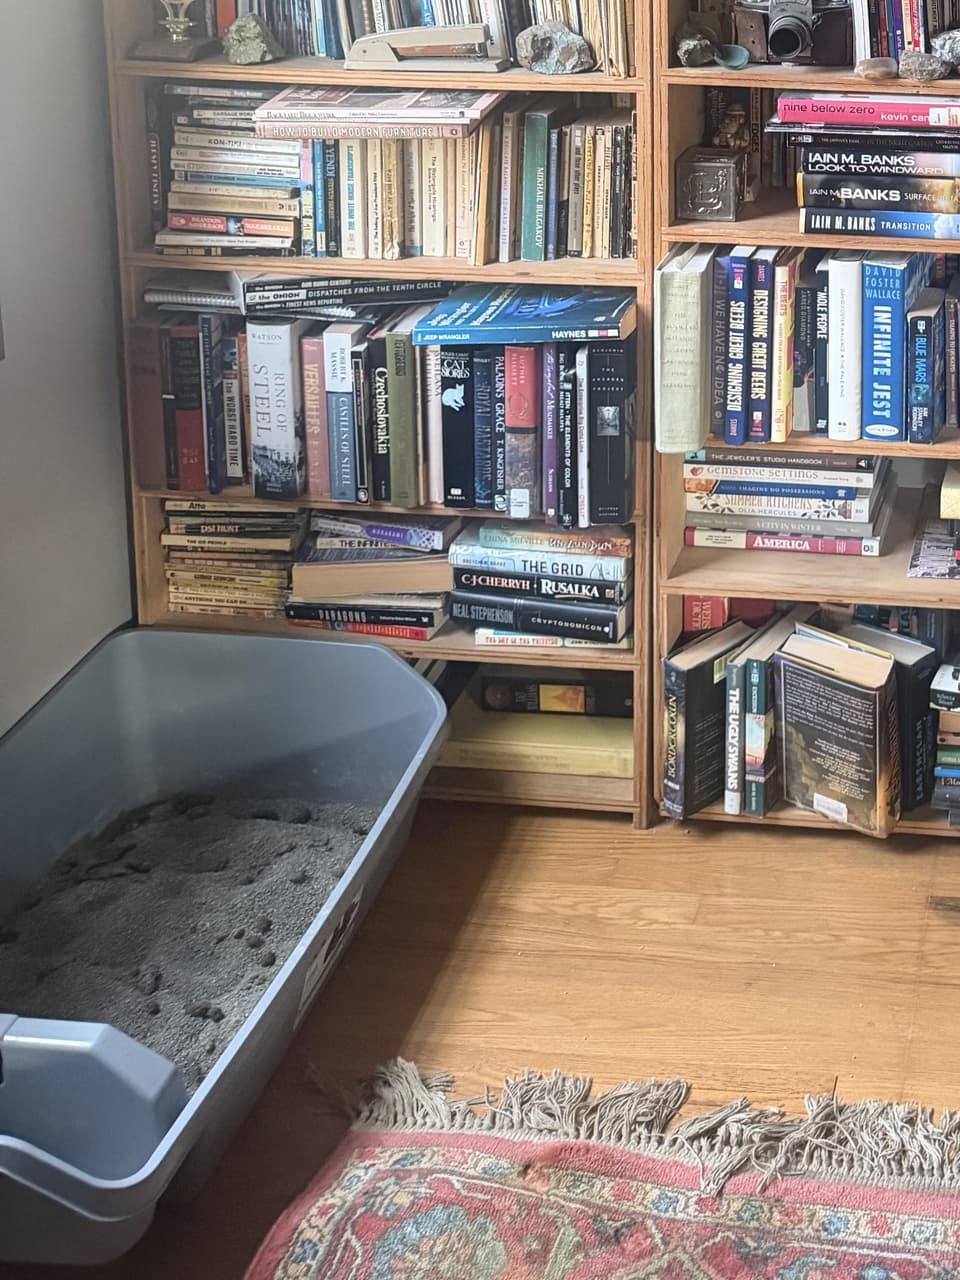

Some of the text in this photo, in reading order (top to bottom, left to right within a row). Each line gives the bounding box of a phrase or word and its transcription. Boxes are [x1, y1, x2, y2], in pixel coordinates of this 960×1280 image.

[783, 104, 875, 115] nine below zero
[273, 127, 433, 137] HOW TO BUILD MODERN FURNITURE
[809, 152, 915, 166] IAIN M. BANKS
[809, 164, 943, 175] LOOK TO WINDWARD
[880, 221, 931, 231] TRANSITION
[308, 282, 442, 298] DISPATCHES FROM THE TENTH CIRCLE
[552, 330, 586, 339] HAYNES
[873, 305, 892, 419] INFINITE JEST
[254, 364, 271, 438] STEEL
[273, 372, 288, 433] RING OF
[374, 367, 391, 455] Czechoslovakia
[753, 536, 811, 550] AMERICA
[521, 559, 584, 576] THE GRID
[541, 580, 599, 598] RUSALKA
[531, 617, 602, 632] CRYPTONOMICON
[727, 688, 739, 790] THE UGLY SWANS
